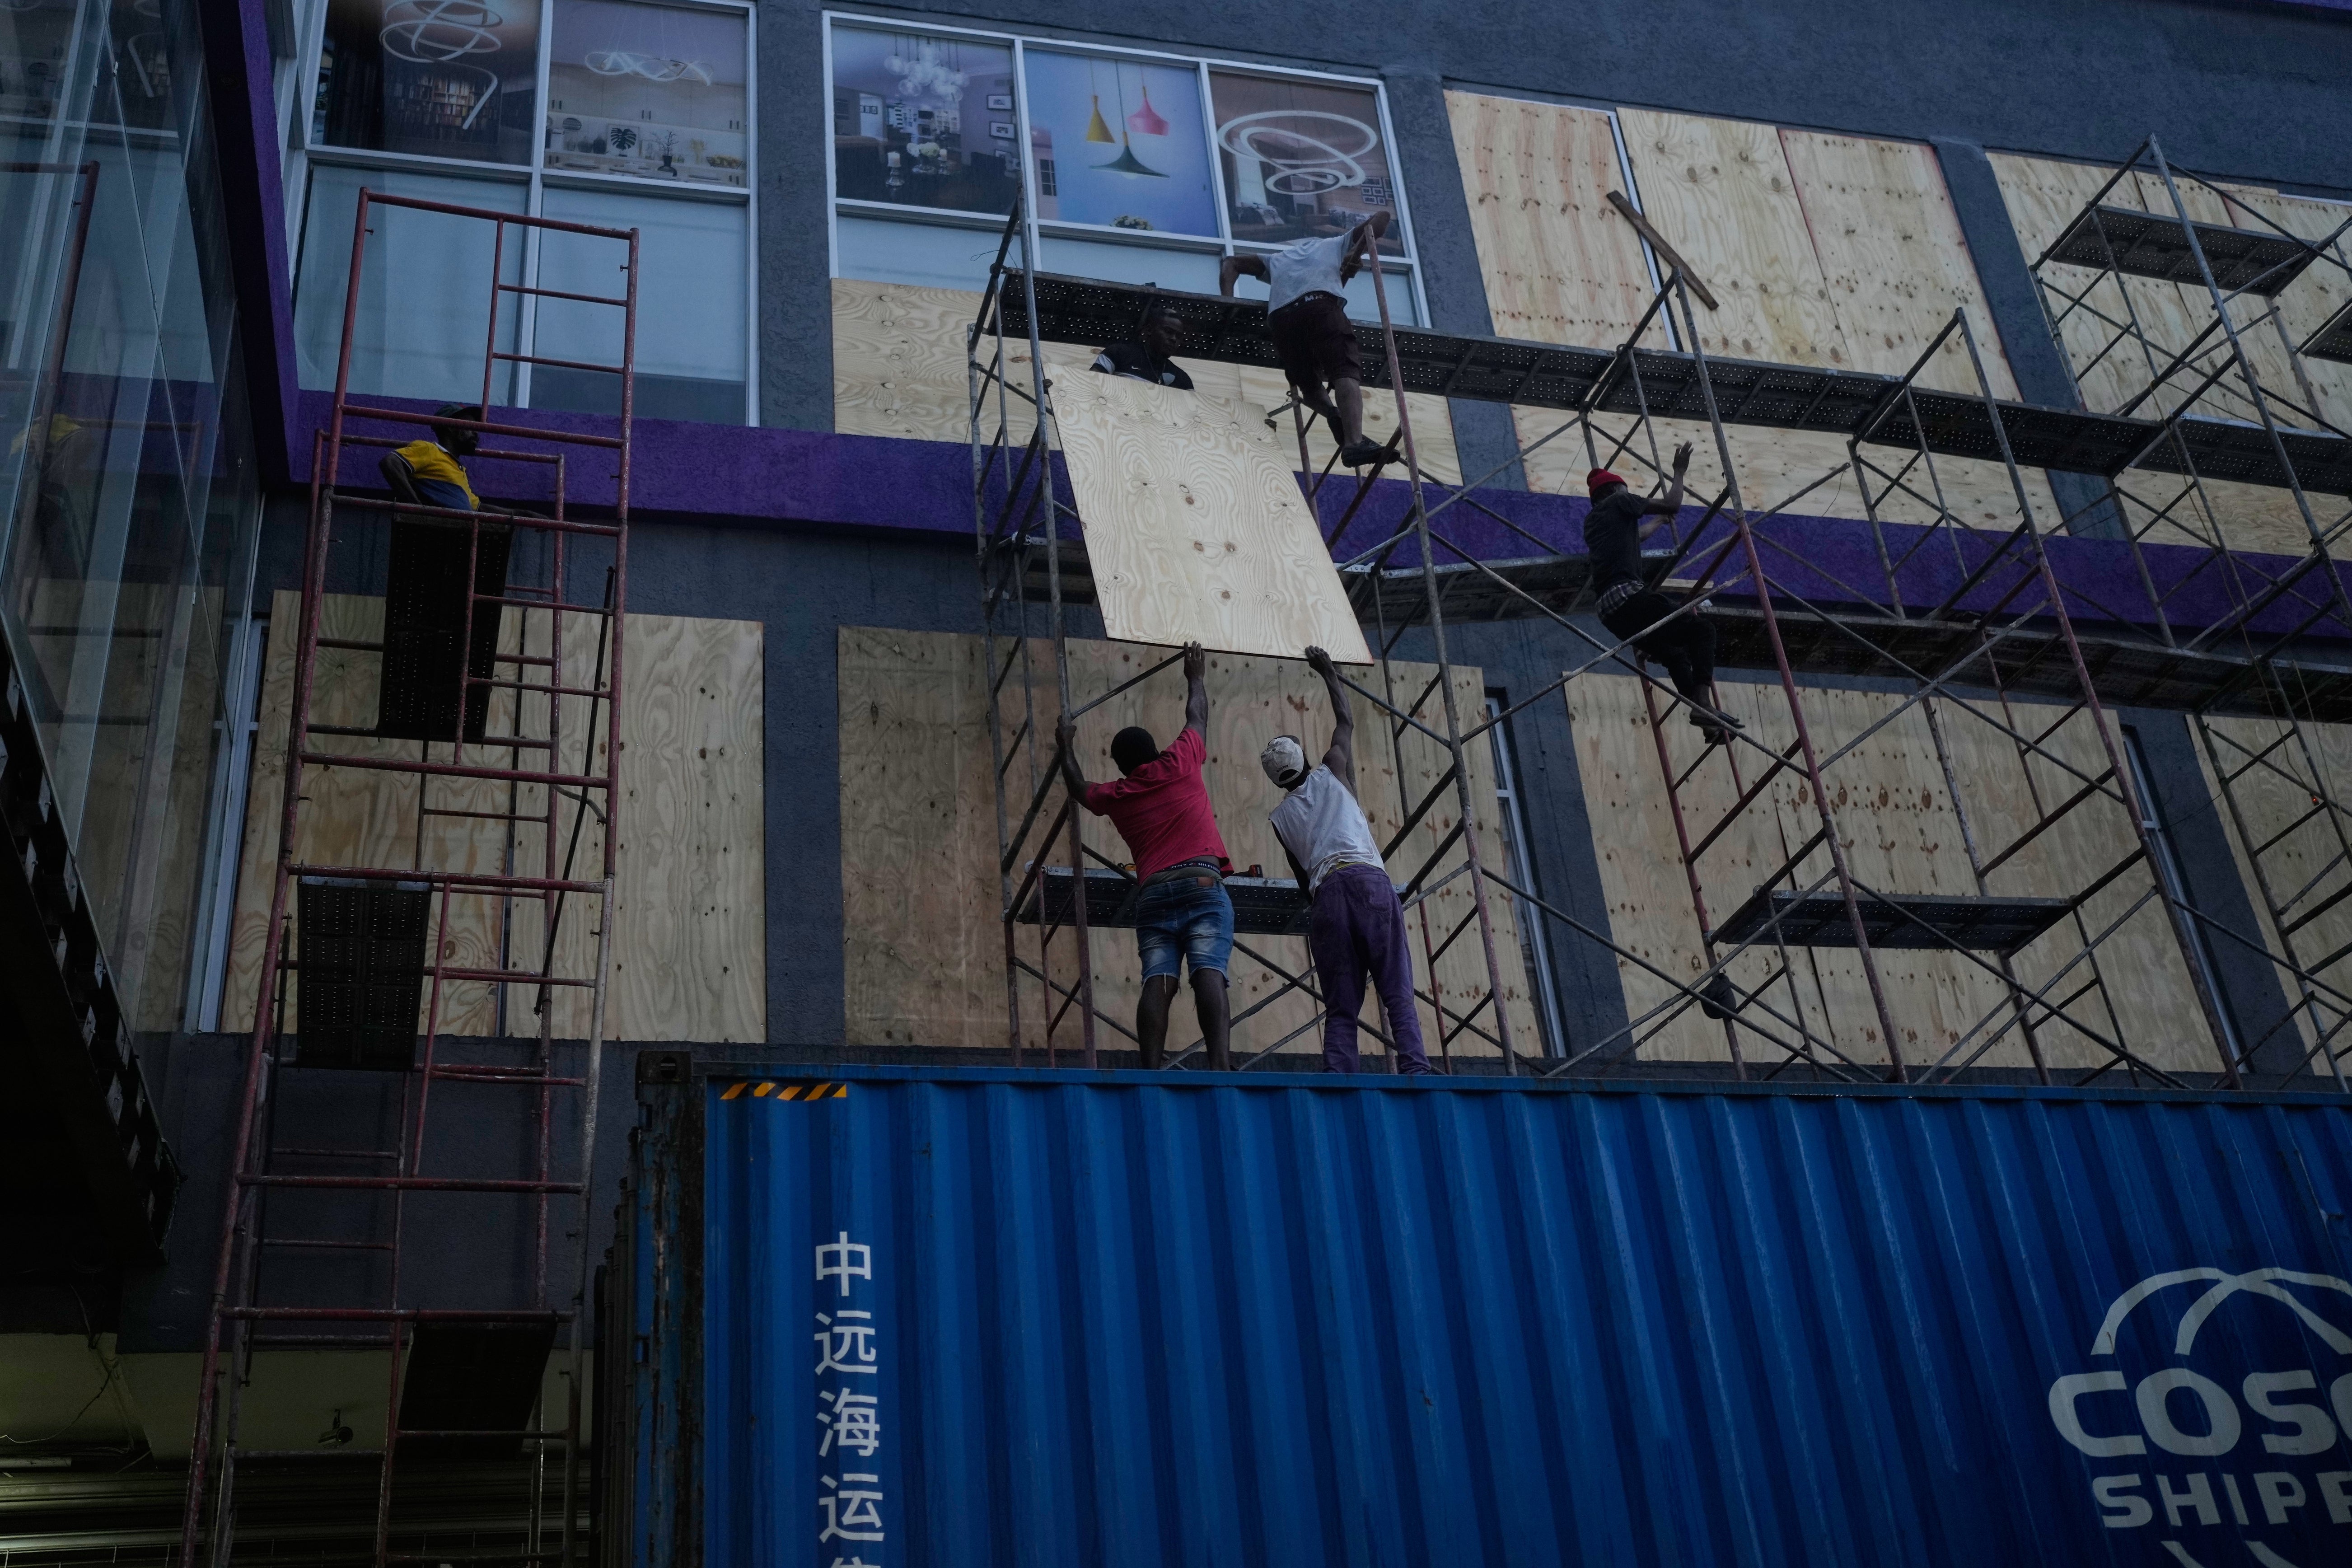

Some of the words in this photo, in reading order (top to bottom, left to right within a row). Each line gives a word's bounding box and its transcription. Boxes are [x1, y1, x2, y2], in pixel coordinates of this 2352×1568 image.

[814, 1231, 884, 1568] 中远海运
[2048, 1368, 2352, 1457] COS
